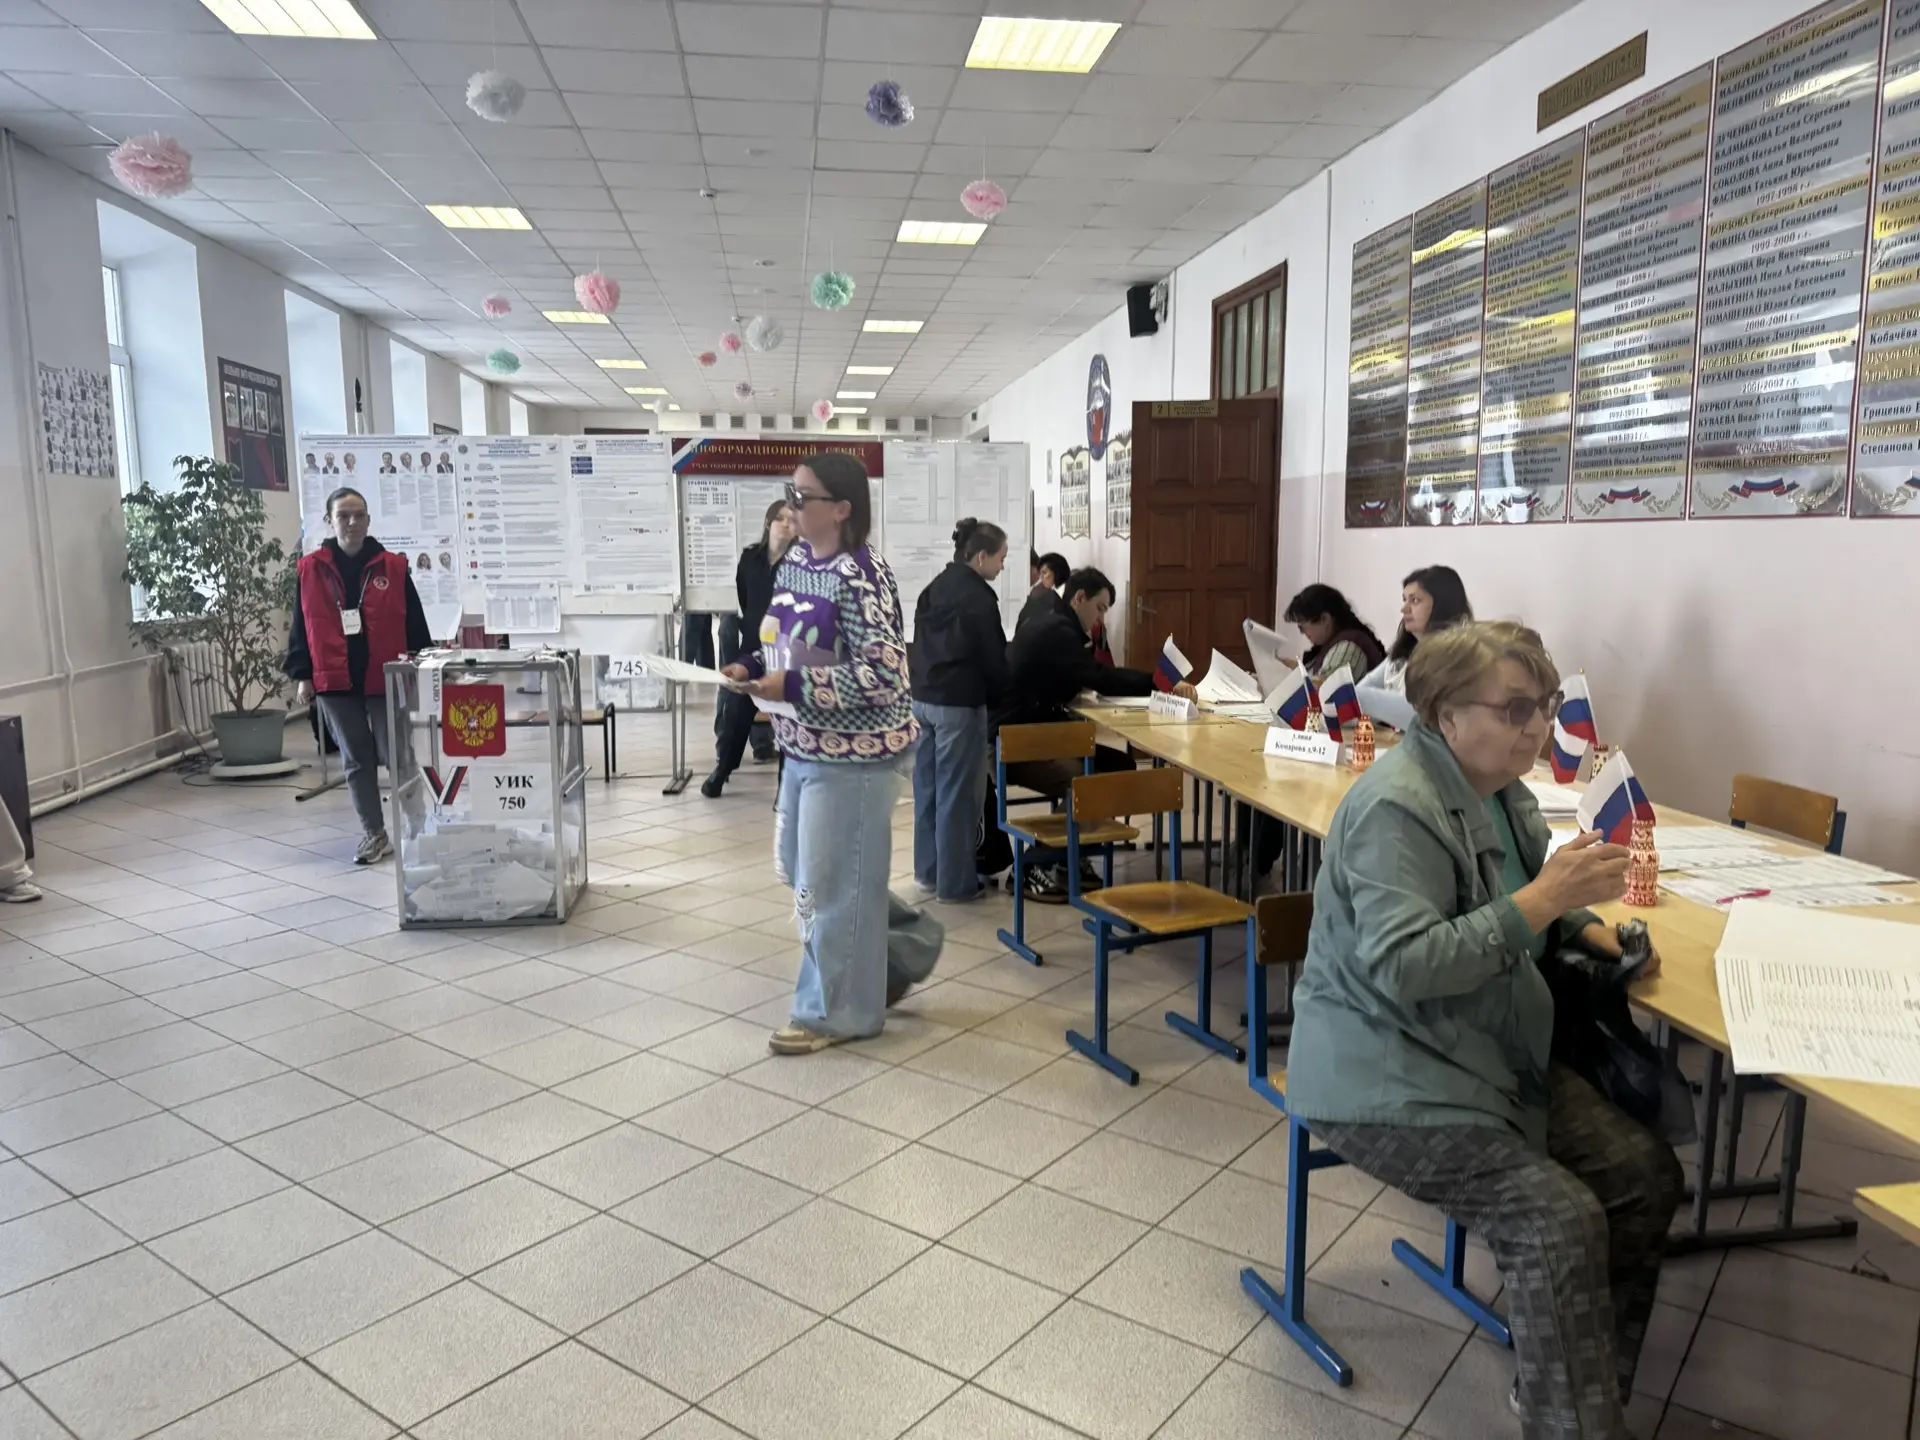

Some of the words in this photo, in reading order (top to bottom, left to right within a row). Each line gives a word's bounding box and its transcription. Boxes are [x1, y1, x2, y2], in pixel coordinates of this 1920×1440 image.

[1765, 75, 1791, 92] Ольга
[1759, 111, 1783, 126] Ольга
[1774, 119, 1800, 136] Елена
[1802, 99, 1850, 123] Сергеевна
[1751, 140, 1787, 161] Наталья
[1712, 165, 1759, 190] СОКОЛОВА
[1762, 157, 1783, 171] Анна
[1785, 137, 1839, 163] Викторовна
[1712, 183, 1751, 205] ФАСТОВА
[1754, 172, 1788, 191] Татьяна
[1790, 156, 1831, 178] Юрьевна
[1750, 202, 1794, 223] Екатерина
[1796, 177, 1868, 207] Александровна
[1711, 231, 1746, 250] ФОКИНА
[1747, 222, 1778, 239] Оксана
[1707, 259, 1753, 281] ЕРМАКОВА
[1755, 255, 1775, 268] Вера
[1777, 239, 1830, 260] Викторовна
[1705, 290, 1754, 311] НИКИТИНА
[1755, 281, 1791, 298] Наталья
[1793, 268, 1845, 288] Евгеньевна
[1707, 273, 1757, 295] МАЛЫХИНА
[1759, 268, 1782, 282] Нина
[1763, 298, 1788, 312] Юлия
[1790, 287, 1836, 305] Сергеевна
[1703, 338, 1742, 354] ВАУЛИНА
[1744, 334, 1770, 347] Дарья
[1771, 323, 1825, 341] Дмитриевна
[1870, 327, 1918, 345] Кобачёва
[1750, 346, 1788, 360] Светлана
[1790, 335, 1846, 353] Николаевна
[1701, 369, 1733, 384] ТРУХАН
[1734, 365, 1764, 378] Оксана
[1766, 357, 1815, 373] Валерьевна
[1733, 398, 1753, 408] Анна
[1754, 390, 1820, 406] Александровна
[1697, 414, 1735, 427] КУВАЕВА
[1863, 404, 1912, 420] Гриценко
[1696, 429, 1730, 441] СЛЕПОВ
[1732, 426, 1761, 439] Андрей
[1763, 420, 1827, 434] Владимирович
[690, 444, 817, 456] ИНФОРМАЦИОННЫЙ
[1860, 442, 1913, 455] Степанова
[613, 661, 643, 676] 745
[493, 775, 534, 789] УИК
[499, 796, 526, 810] 750
